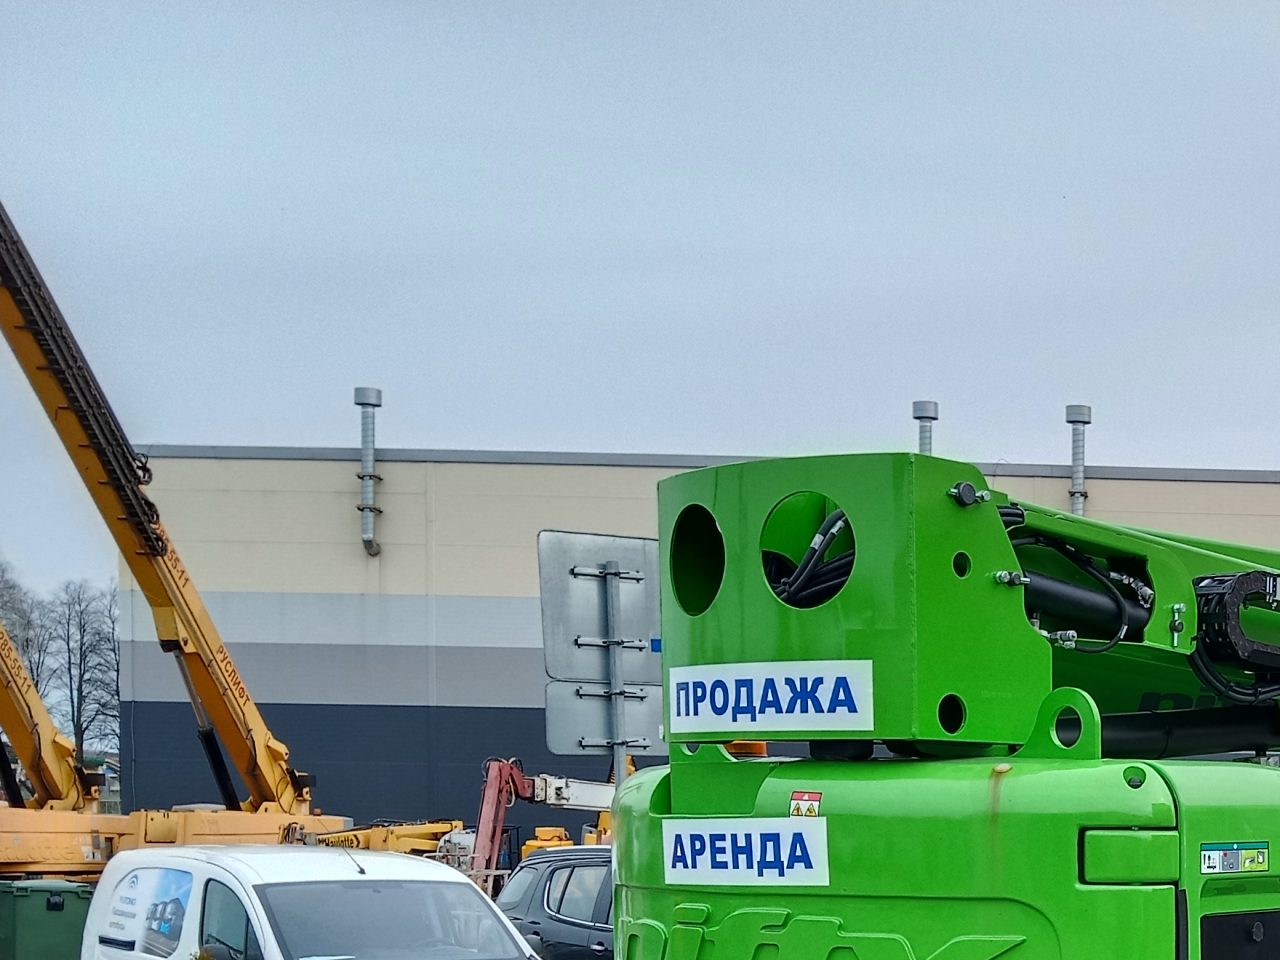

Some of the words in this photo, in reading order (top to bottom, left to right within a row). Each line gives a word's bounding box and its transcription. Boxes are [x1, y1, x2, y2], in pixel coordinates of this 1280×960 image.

[216, 645, 250, 707] РУСЛИФТ
[676, 676, 858, 722] ПРОДАЖА
[671, 832, 814, 877] АРЕНДА
